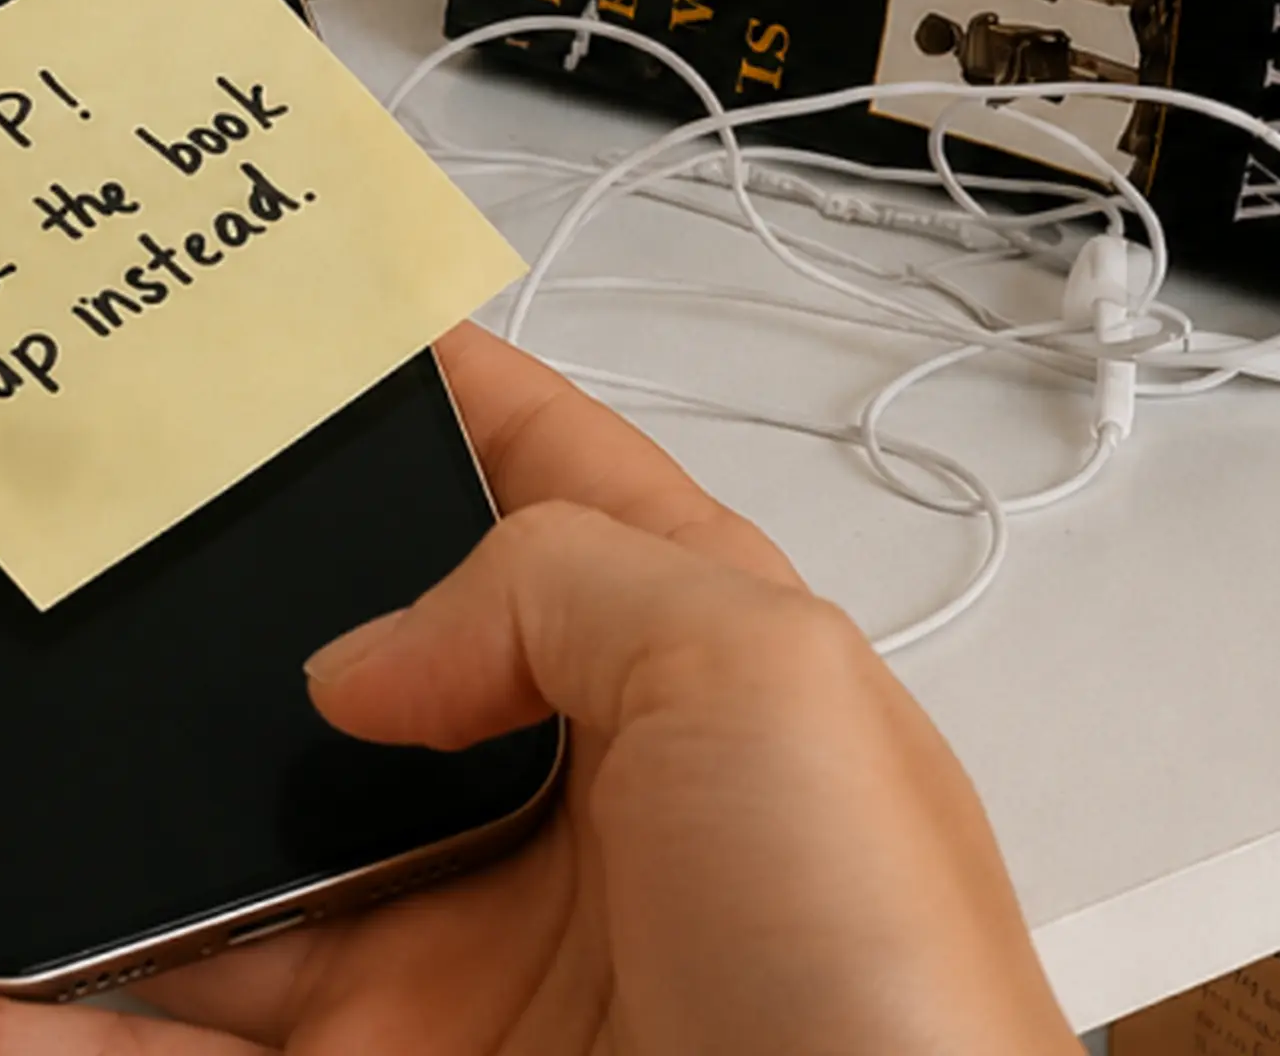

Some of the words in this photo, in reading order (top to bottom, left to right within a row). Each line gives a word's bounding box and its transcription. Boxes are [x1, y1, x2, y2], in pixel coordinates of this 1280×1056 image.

[735, 17, 790, 94] IS
[32, 181, 140, 240] the
[134, 75, 289, 175] book
[71, 162, 317, 337] instead.
